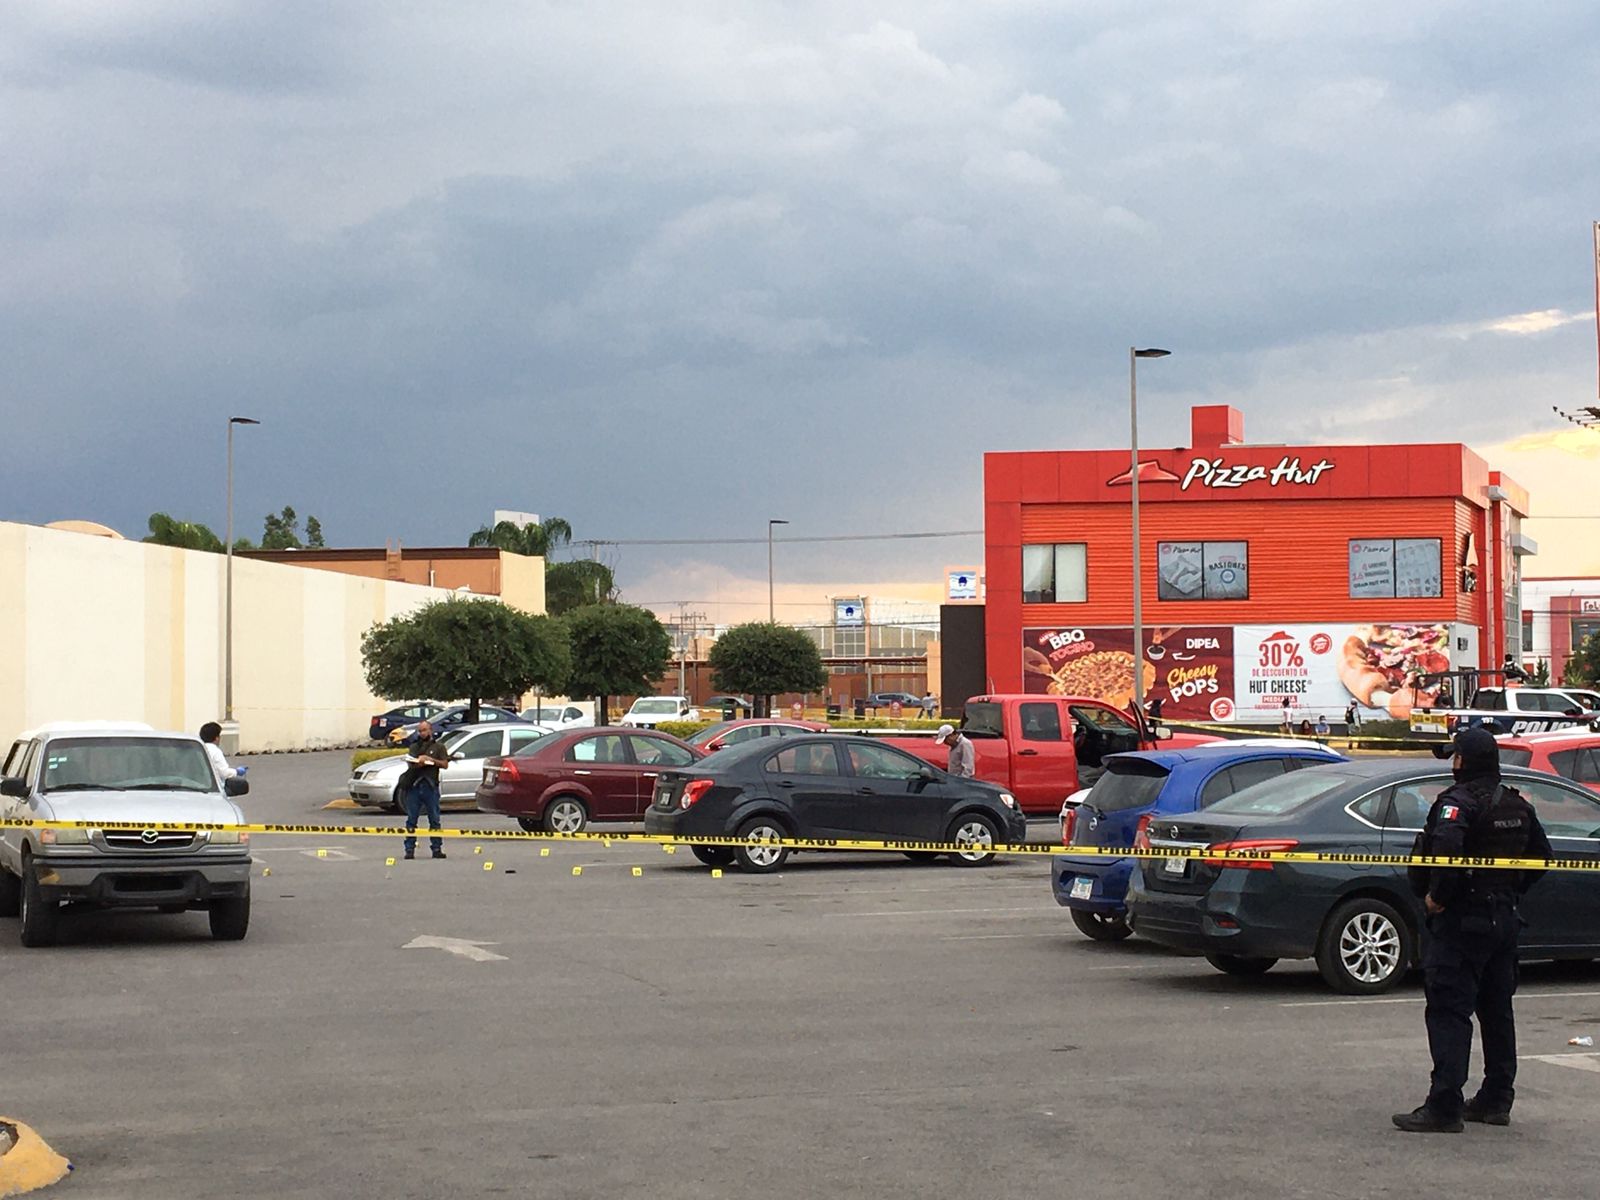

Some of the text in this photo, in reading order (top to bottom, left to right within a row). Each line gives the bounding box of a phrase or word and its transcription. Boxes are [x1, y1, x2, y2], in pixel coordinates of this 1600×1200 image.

[1181, 457, 1335, 491] Pizza Hut
[1049, 629, 1085, 650] BBQ
[1186, 638, 1220, 649] DIPEA
[1049, 641, 1095, 661] TOCINO
[1259, 643, 1304, 668] 30%
[1167, 664, 1219, 687] Cheesy
[1252, 668, 1308, 677] DE DESCUENTO EN
[1170, 678, 1219, 703] POPS
[1249, 679, 1267, 693] HUT
